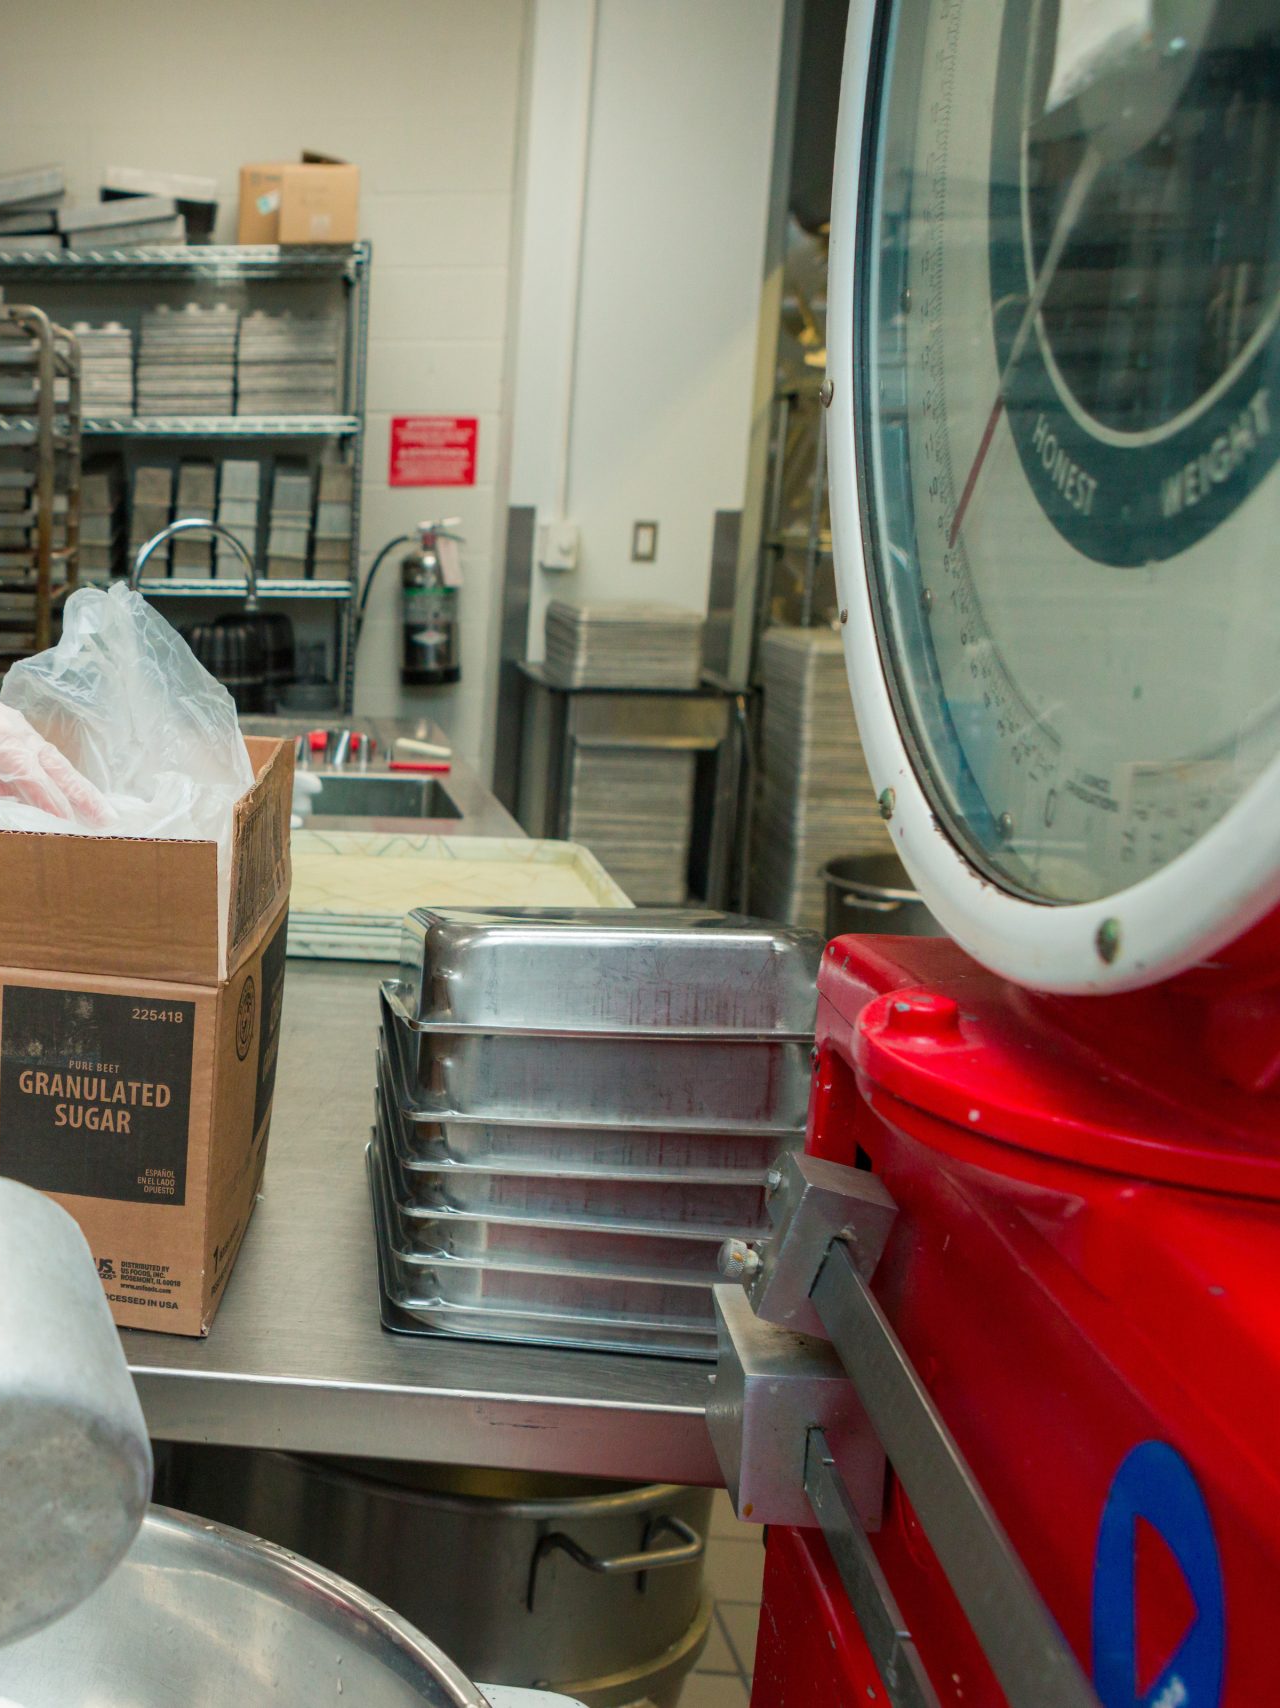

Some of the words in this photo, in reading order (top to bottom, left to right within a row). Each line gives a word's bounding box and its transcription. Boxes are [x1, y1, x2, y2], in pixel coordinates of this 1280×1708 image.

[1032, 412, 1097, 517] HONEST
[132, 1008, 184, 1023] 225418
[69, 1060, 93, 1071] PURE
[96, 1063, 120, 1074] BEET
[19, 1070, 171, 1108] GRANULATED
[54, 1103, 131, 1134] SUGAR
[145, 1168, 175, 1179] ESPAÑOL
[137, 1176, 146, 1185] EN
[147, 1177, 155, 1185] EL
[156, 1178, 175, 1187] LADO
[143, 1185, 175, 1195] OPUESTO
[120, 1267, 129, 1275] US
[121, 1261, 160, 1272] DISTRIBUTED
[161, 1265, 170, 1273] BY
[147, 1299, 157, 1308] IN
[159, 1300, 179, 1310] USA
